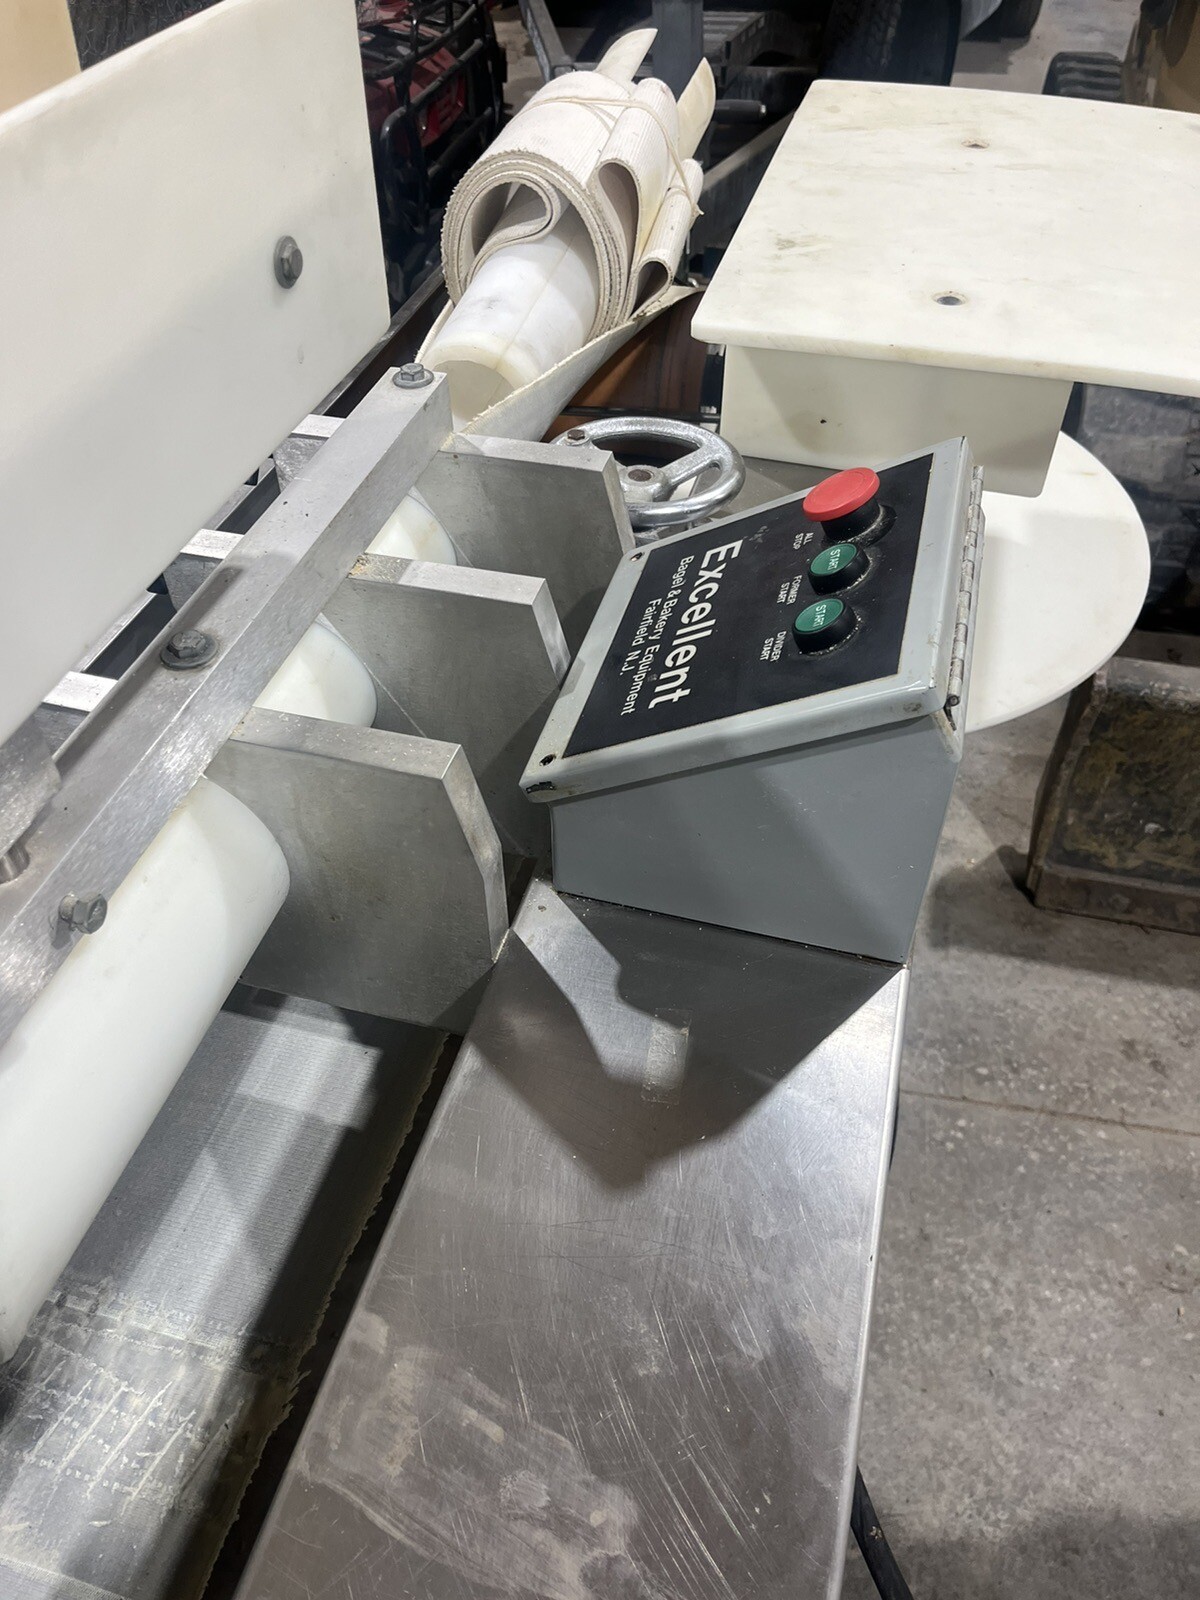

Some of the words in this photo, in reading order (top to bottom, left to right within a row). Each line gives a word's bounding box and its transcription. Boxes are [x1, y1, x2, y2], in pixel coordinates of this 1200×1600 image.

[671, 555, 694, 588] Bagel
[828, 549, 841, 570] START
[667, 589, 681, 599] &
[777, 582, 790, 603] START
[786, 575, 802, 605] FORMER
[631, 598, 662, 646] Fairfield
[648, 598, 678, 640] Bakery
[648, 539, 744, 710] Excellent
[813, 604, 826, 627] START
[760, 637, 774, 660] START
[770, 631, 787, 662] DIVIDER
[620, 650, 642, 676] N.J.
[620, 644, 660, 716] Equipment
